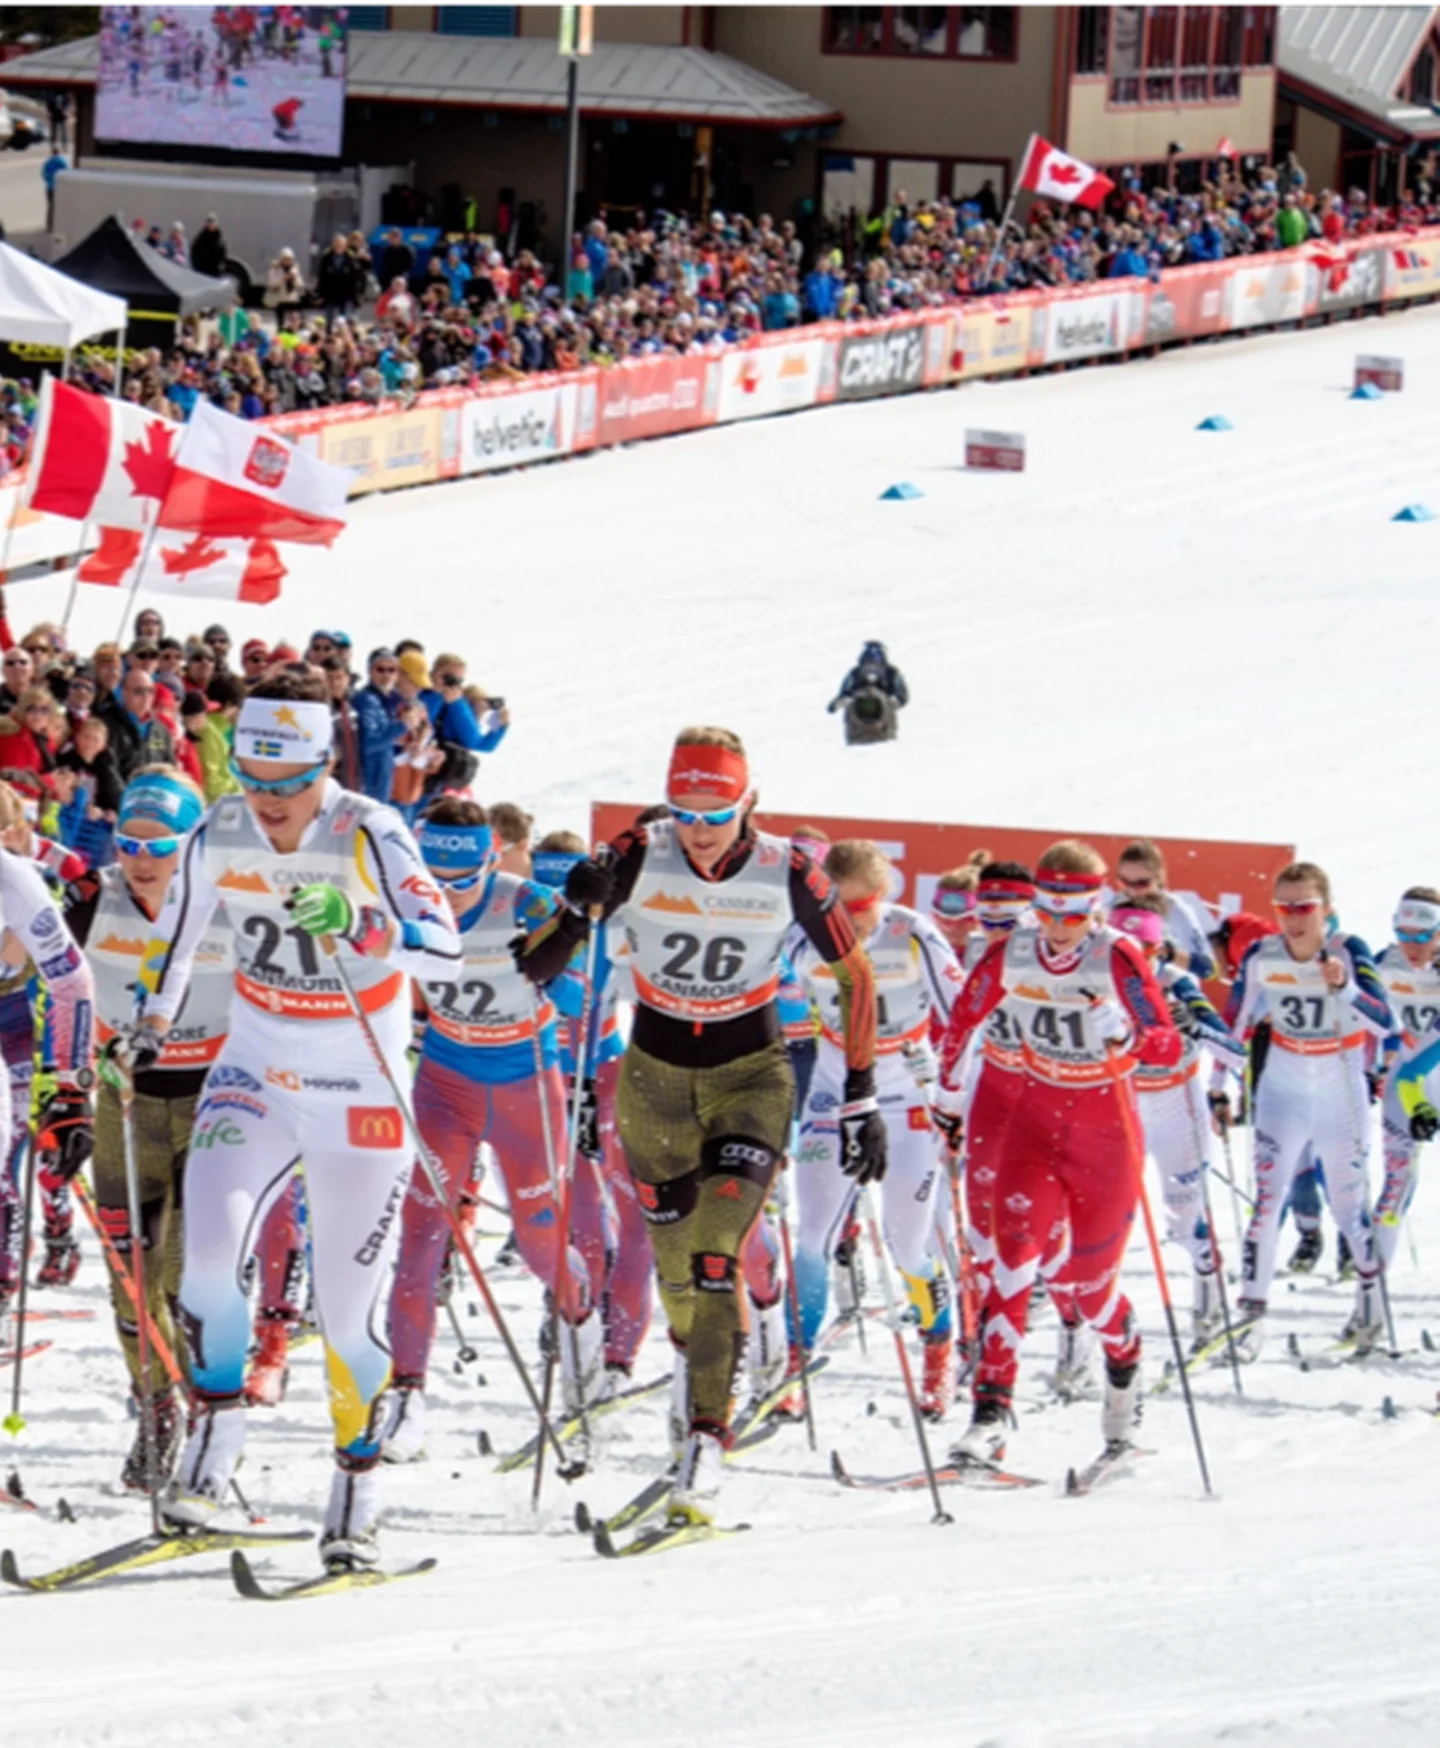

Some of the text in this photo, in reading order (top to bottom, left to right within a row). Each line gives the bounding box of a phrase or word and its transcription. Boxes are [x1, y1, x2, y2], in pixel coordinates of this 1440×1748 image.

[841, 334, 905, 387] CRAFT
[243, 915, 320, 977] 21
[662, 931, 747, 983] 26
[426, 980, 497, 1018] 22
[650, 972, 749, 999] CANMORE
[1031, 1005, 1086, 1049] 41
[1279, 995, 1326, 1030] 37
[352, 1187, 403, 1267] CRAFT
